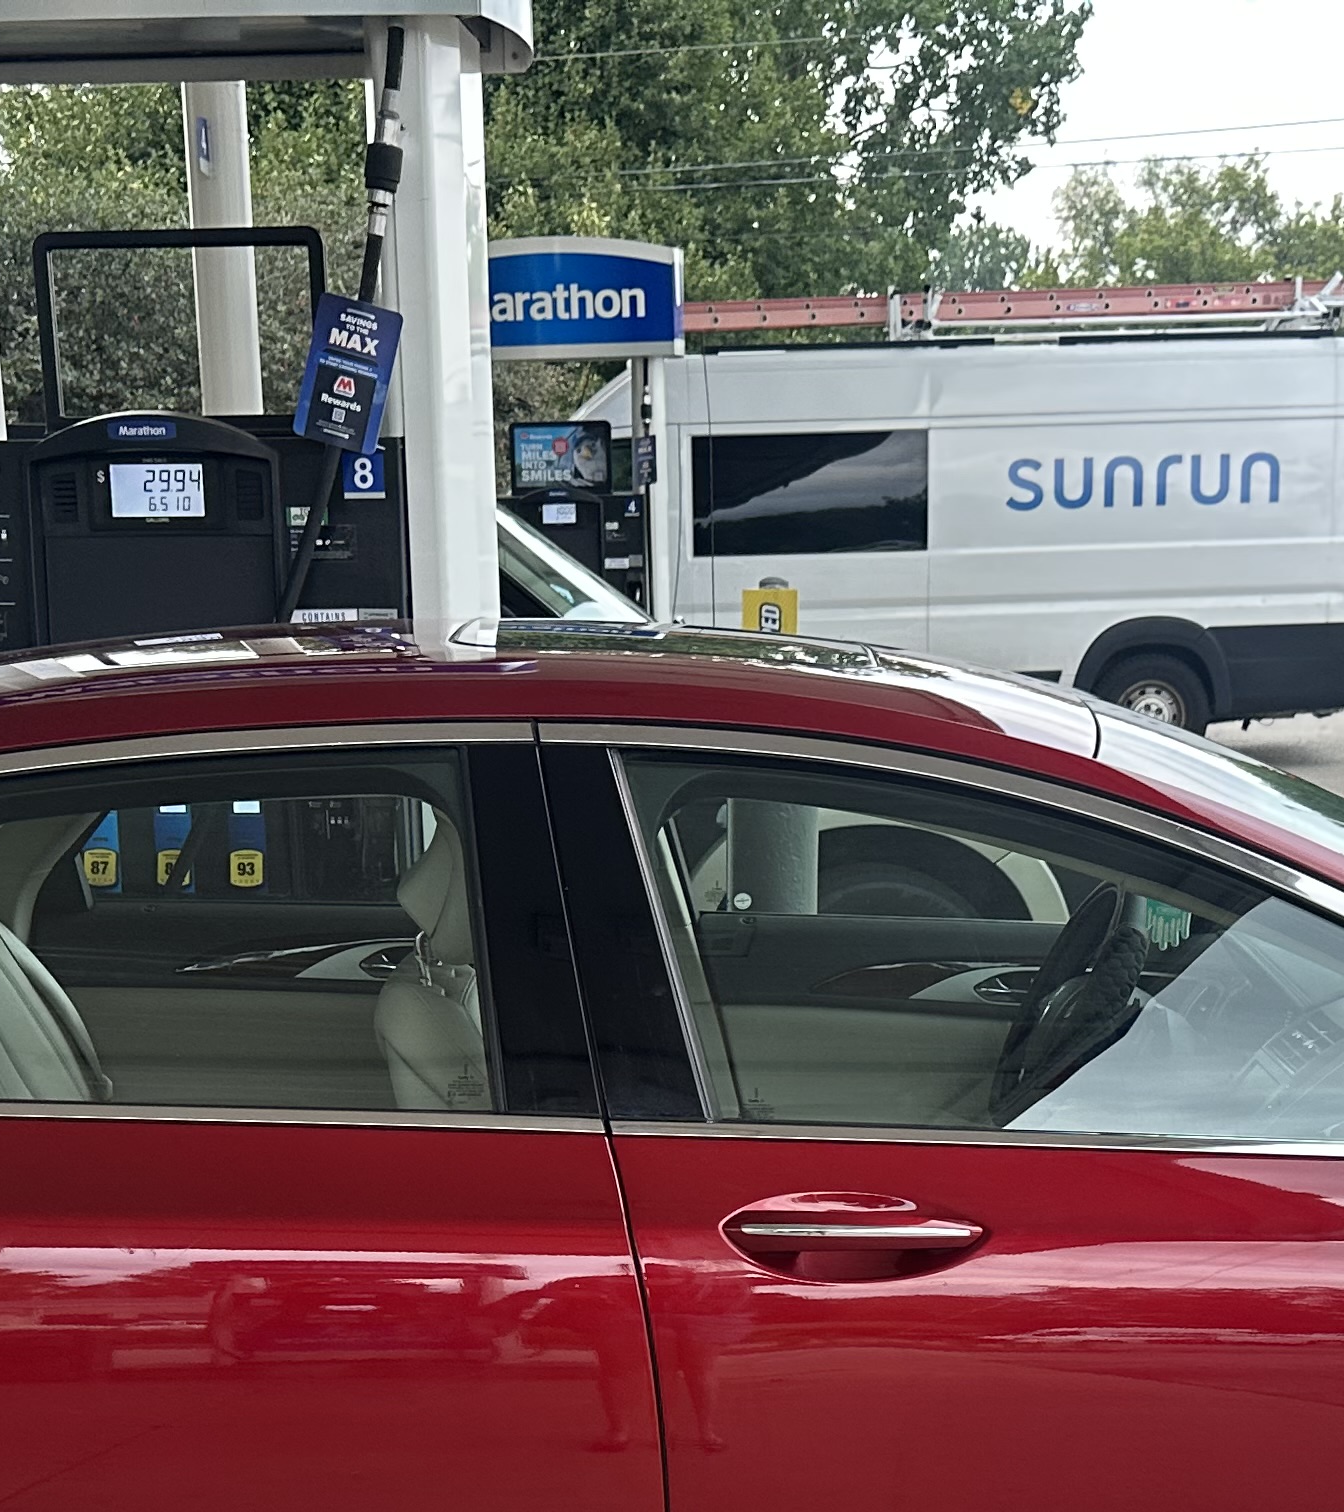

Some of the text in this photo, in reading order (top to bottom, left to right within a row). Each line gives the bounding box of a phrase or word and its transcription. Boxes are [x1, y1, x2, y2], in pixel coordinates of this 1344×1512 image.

[489, 283, 646, 322] arathon
[340, 313, 378, 330] SAVINGS
[328, 327, 379, 357] MAX
[320, 392, 362, 412] Rewards
[118, 426, 166, 436] Marathon
[96, 470, 105, 483] $
[143, 469, 201, 492] 29.94
[353, 457, 374, 489] 8
[521, 470, 571, 481] SMILES
[1006, 452, 1280, 511] sunrun
[628, 500, 636, 513] 4
[301, 611, 346, 623] CONTAINS
[90, 860, 109, 875] 87
[237, 862, 255, 876] 93
